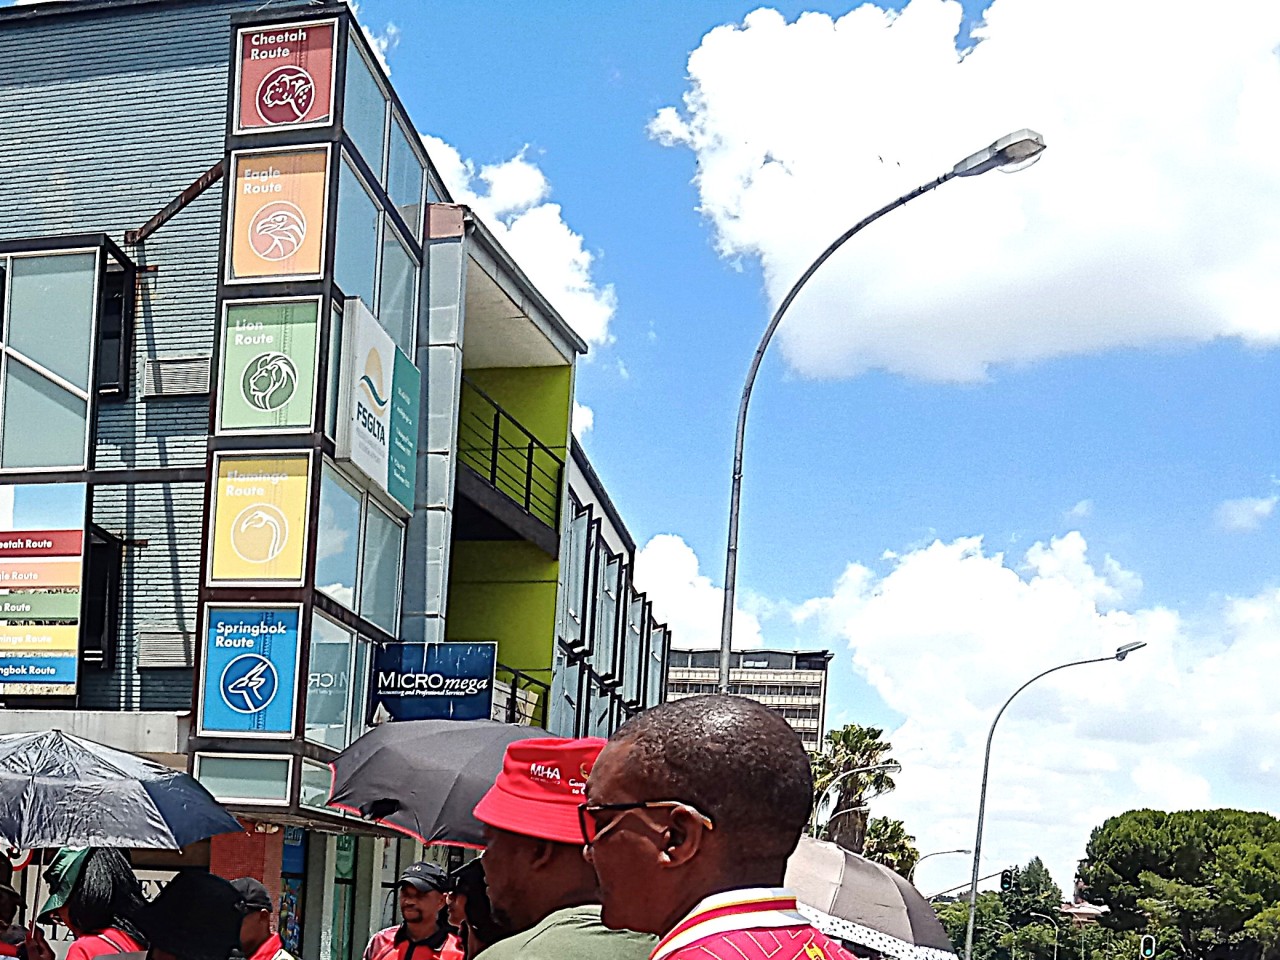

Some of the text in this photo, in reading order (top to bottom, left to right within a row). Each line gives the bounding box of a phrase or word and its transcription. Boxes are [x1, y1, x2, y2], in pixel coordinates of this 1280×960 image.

[251, 29, 307, 45] Cheetah
[250, 45, 290, 61] Route
[243, 166, 281, 181] Eagle
[243, 181, 282, 194] Route
[235, 319, 264, 333] Lion
[234, 332, 273, 345] Route
[226, 470, 289, 483] Flamingo
[226, 484, 265, 497] Route
[25, 539, 53, 549] Route
[11, 571, 38, 580] Route
[4, 603, 31, 612] Route
[216, 621, 287, 637] Springbok
[25, 634, 52, 644] Route
[215, 635, 255, 649] Route
[29, 666, 56, 675] Route
[531, 763, 560, 779] MHA
